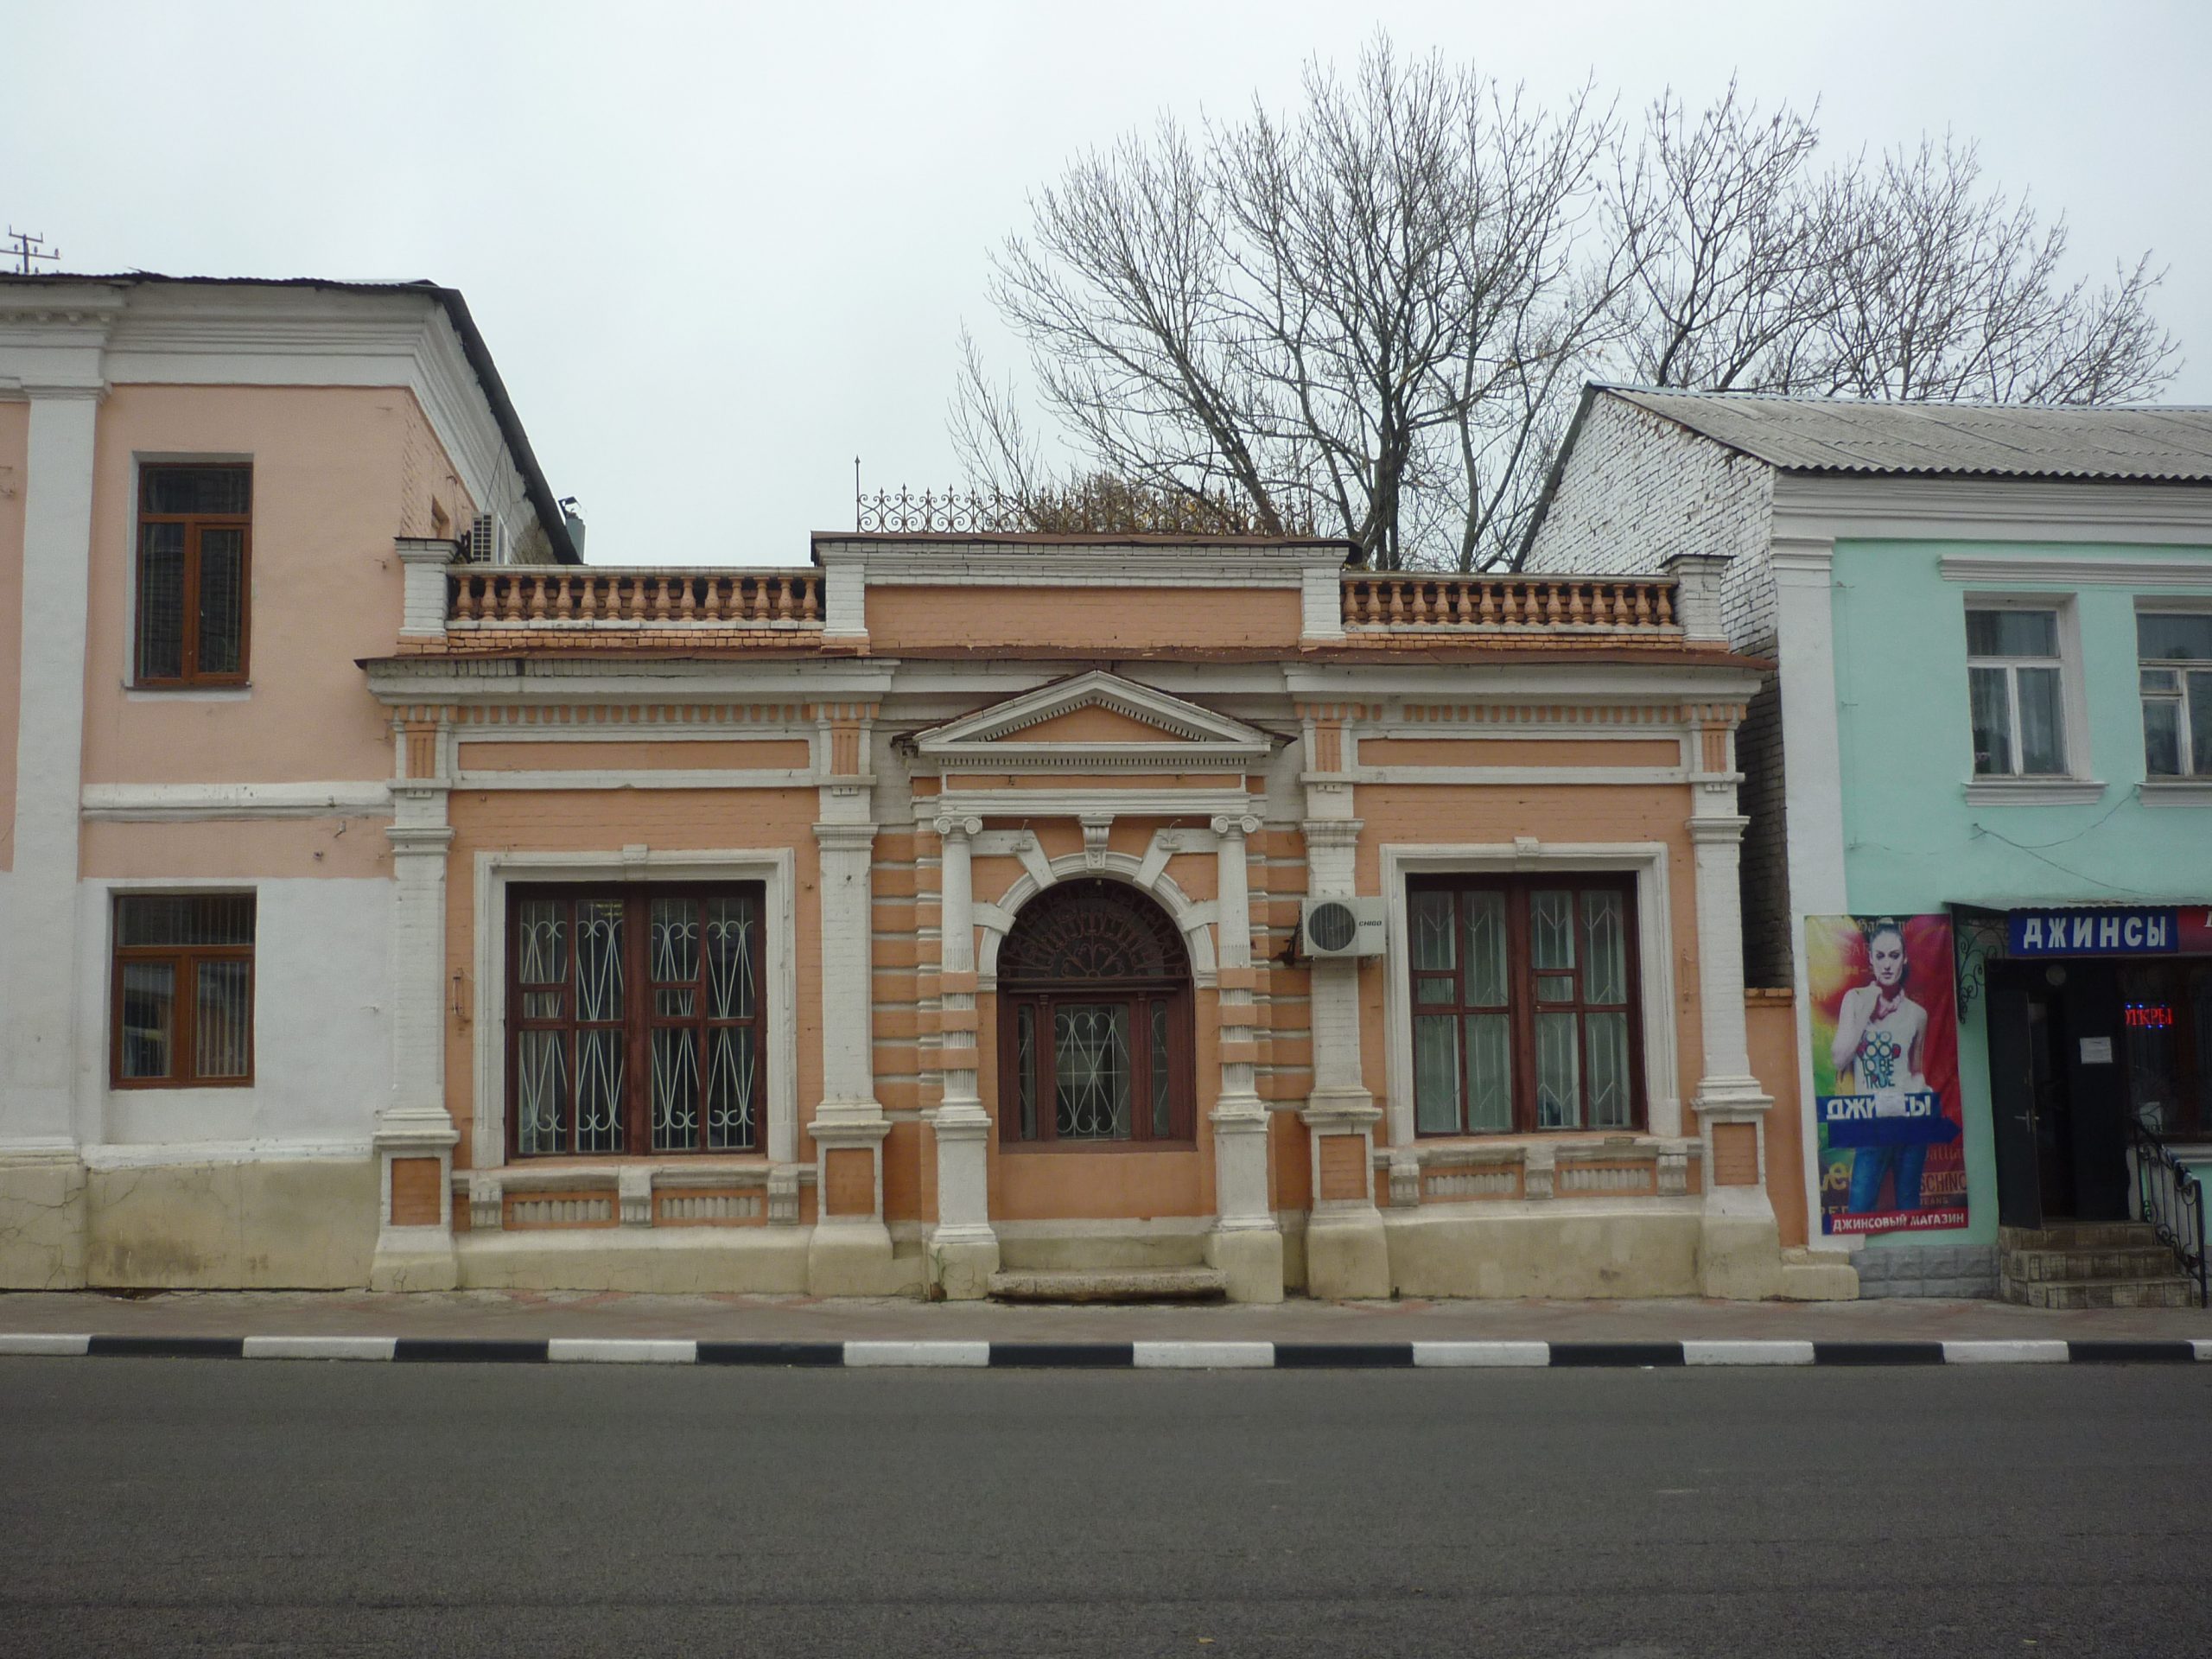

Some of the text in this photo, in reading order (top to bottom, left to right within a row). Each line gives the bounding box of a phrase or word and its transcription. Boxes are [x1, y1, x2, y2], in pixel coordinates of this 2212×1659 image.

[2023, 916, 2166, 949] ДЖИНСЫ
[1878, 1058, 1895, 1074] BE
[1864, 1072, 1896, 1089] TRUE
[1833, 1212, 1965, 1232] ДЖИНСОВЫЙ МАГАЗИН
